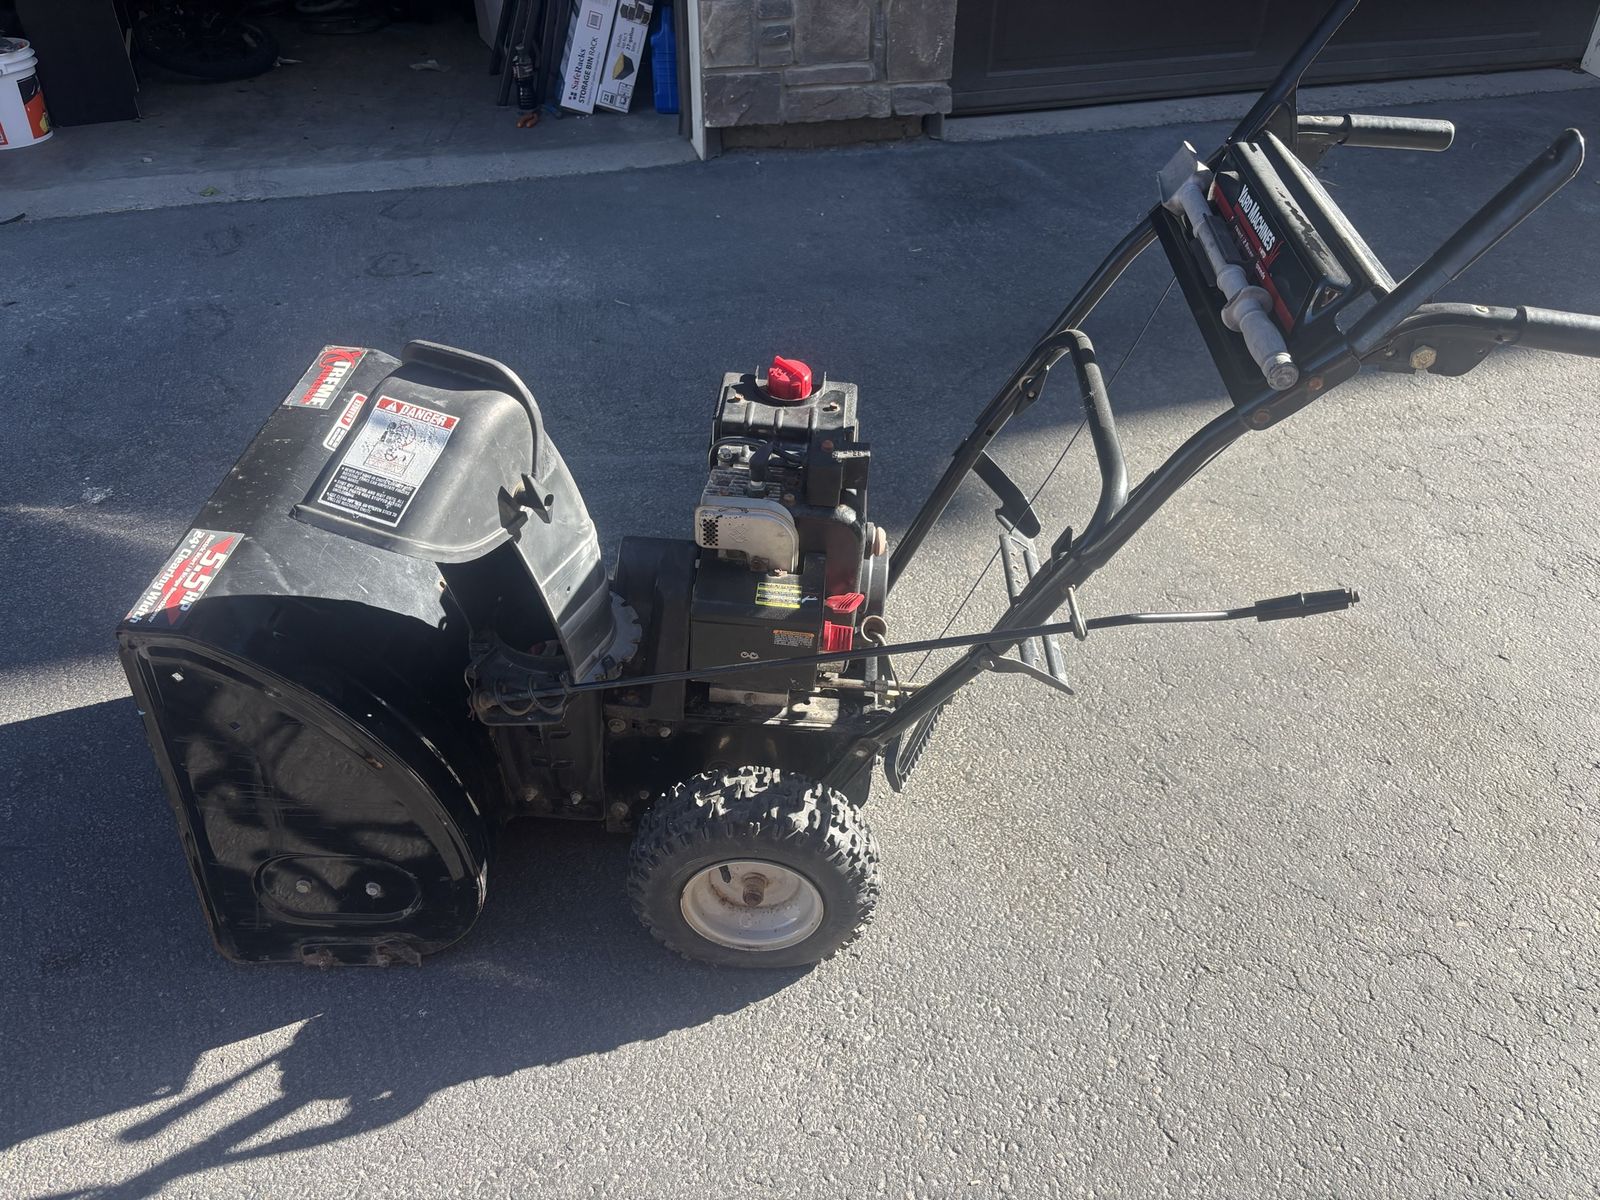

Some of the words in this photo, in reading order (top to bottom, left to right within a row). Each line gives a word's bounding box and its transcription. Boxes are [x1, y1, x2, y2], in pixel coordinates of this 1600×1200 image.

[586, 56, 594, 69] BIN
[589, 37, 599, 56] RACK
[572, 49, 587, 90] SafeRacks
[578, 70, 590, 104] STORAGE
[1238, 184, 1253, 213] YARD
[1248, 202, 1275, 251] MACHINES
[305, 349, 363, 407] XTREME
[399, 404, 447, 427] DANGER
[154, 548, 191, 591] Clearing
[129, 591, 162, 624] Width
